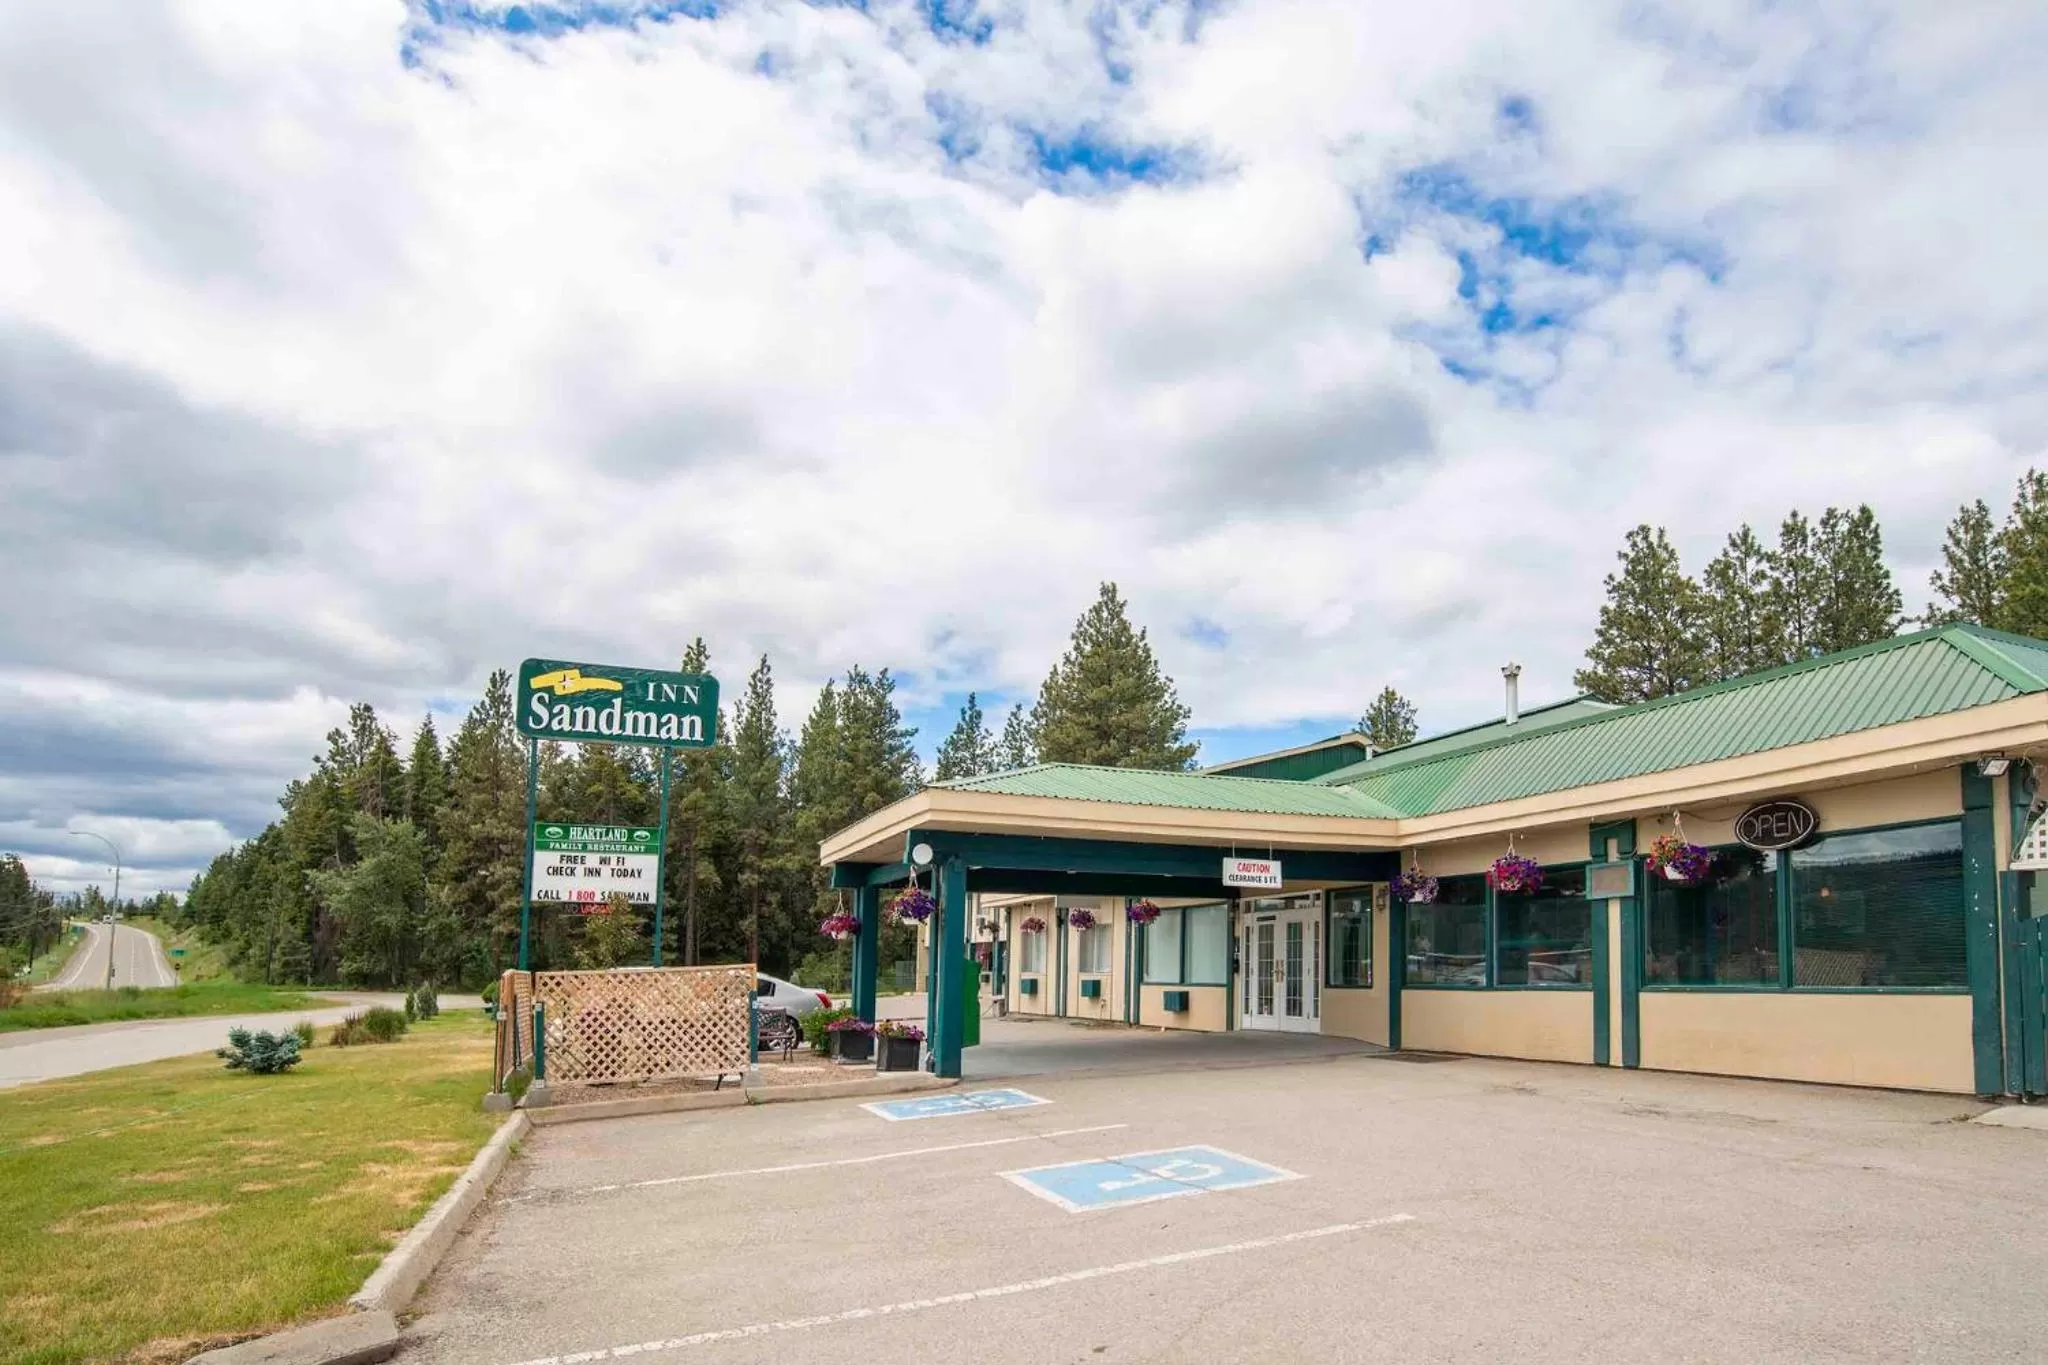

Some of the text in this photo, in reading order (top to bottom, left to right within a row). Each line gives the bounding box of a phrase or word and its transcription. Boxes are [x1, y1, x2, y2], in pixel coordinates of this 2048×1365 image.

[647, 681, 700, 705] INN
[528, 691, 704, 741] Sandman
[1740, 810, 1804, 841] OPEN
[569, 826, 628, 841] HEARTLAND
[549, 841, 646, 852] FAMILY RESTAURANT
[559, 855, 587, 865] FREE
[546, 866, 643, 879] CHECK INN TODAY
[1237, 863, 1271, 874] CAUTION
[1228, 874, 1262, 884] CLEARANCE
[537, 889, 561, 900] CALL
[577, 890, 596, 901] 800
